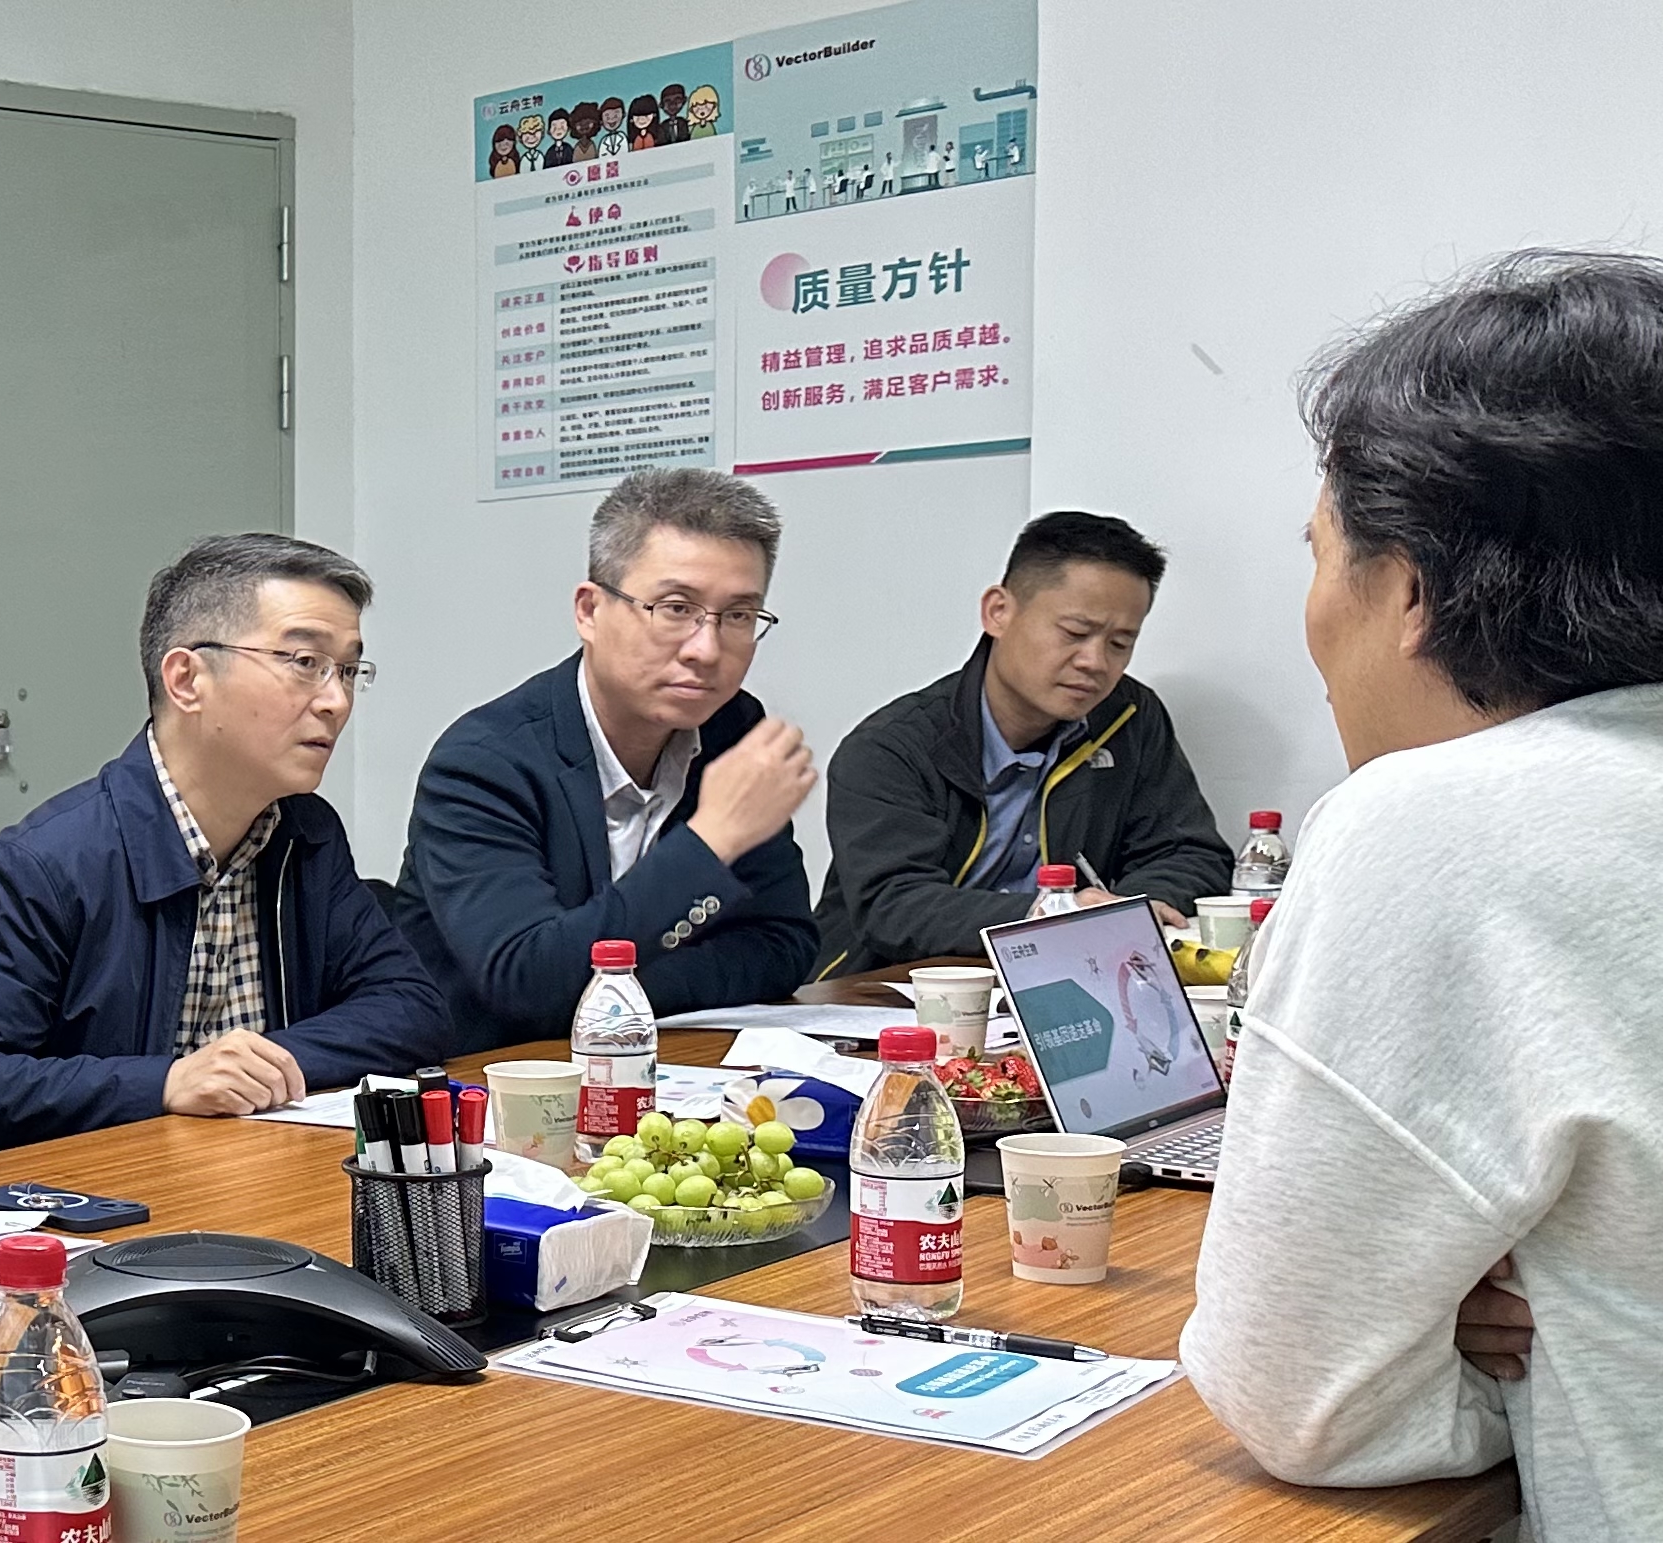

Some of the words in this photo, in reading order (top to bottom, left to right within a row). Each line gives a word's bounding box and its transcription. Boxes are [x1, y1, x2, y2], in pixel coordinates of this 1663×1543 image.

[775, 38, 876, 68] VectorBuilder
[498, 95, 544, 115] 云舟生物
[587, 160, 619, 182] 愿景
[588, 203, 622, 225] 使命
[588, 244, 658, 272] 指导原则
[792, 247, 971, 314] 质量方针
[500, 292, 545, 308] 诚实正直
[500, 322, 546, 339] 创造价值
[501, 350, 545, 366] 关注客户
[501, 428, 546, 442] 尊重他人
[919, 1230, 962, 1251] 农夫山
[60, 1513, 112, 1543] 农夫山
